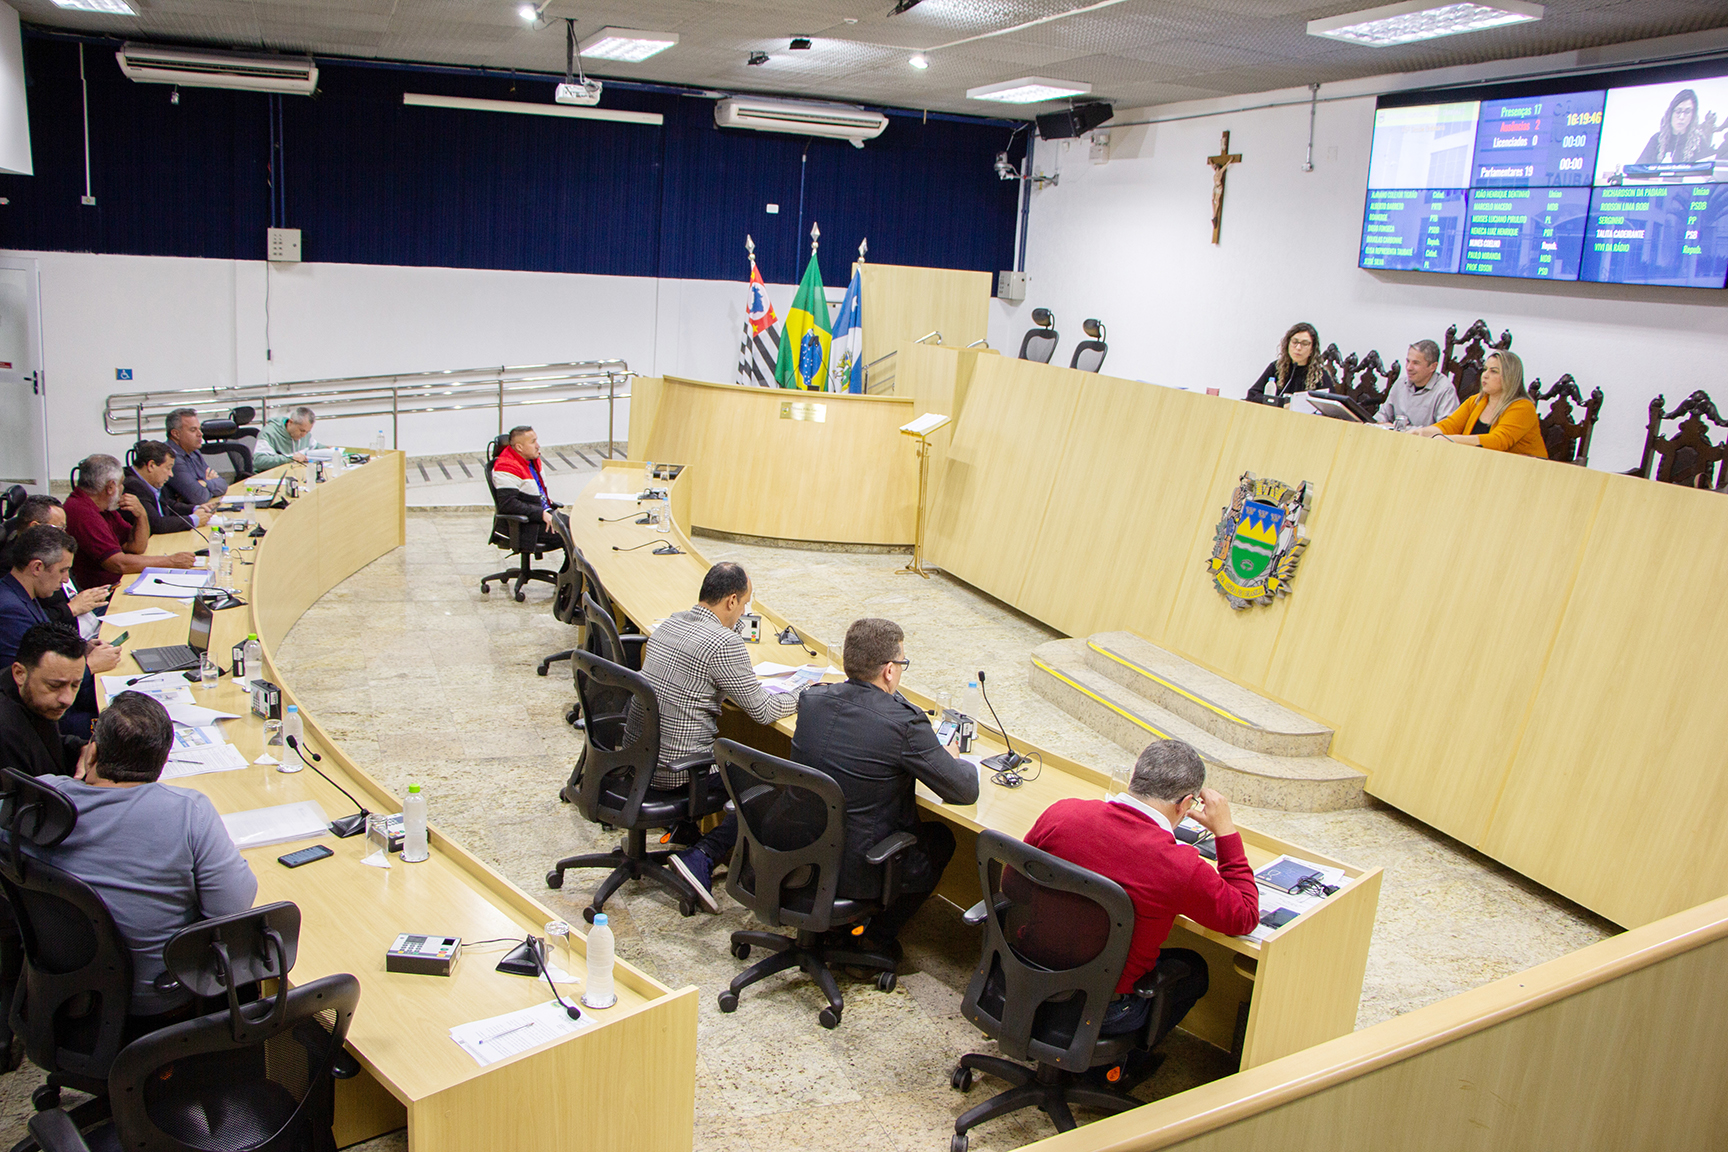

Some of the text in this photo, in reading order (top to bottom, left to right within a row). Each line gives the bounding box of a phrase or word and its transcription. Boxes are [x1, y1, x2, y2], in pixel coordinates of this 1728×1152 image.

[1500, 106, 1532, 118] Presenças
[1534, 104, 1542, 115] 17
[1500, 119, 1541, 132] Ausências 2
[1567, 112, 1603, 126] 16:19:46
[1493, 136, 1528, 148] Licenciados
[1532, 135, 1538, 146] 0
[1562, 135, 1586, 148] 00:00
[1559, 158, 1583, 170] 00:00
[1480, 166, 1534, 178] Parlamentares 19
[1684, 230, 1698, 240] PSB
